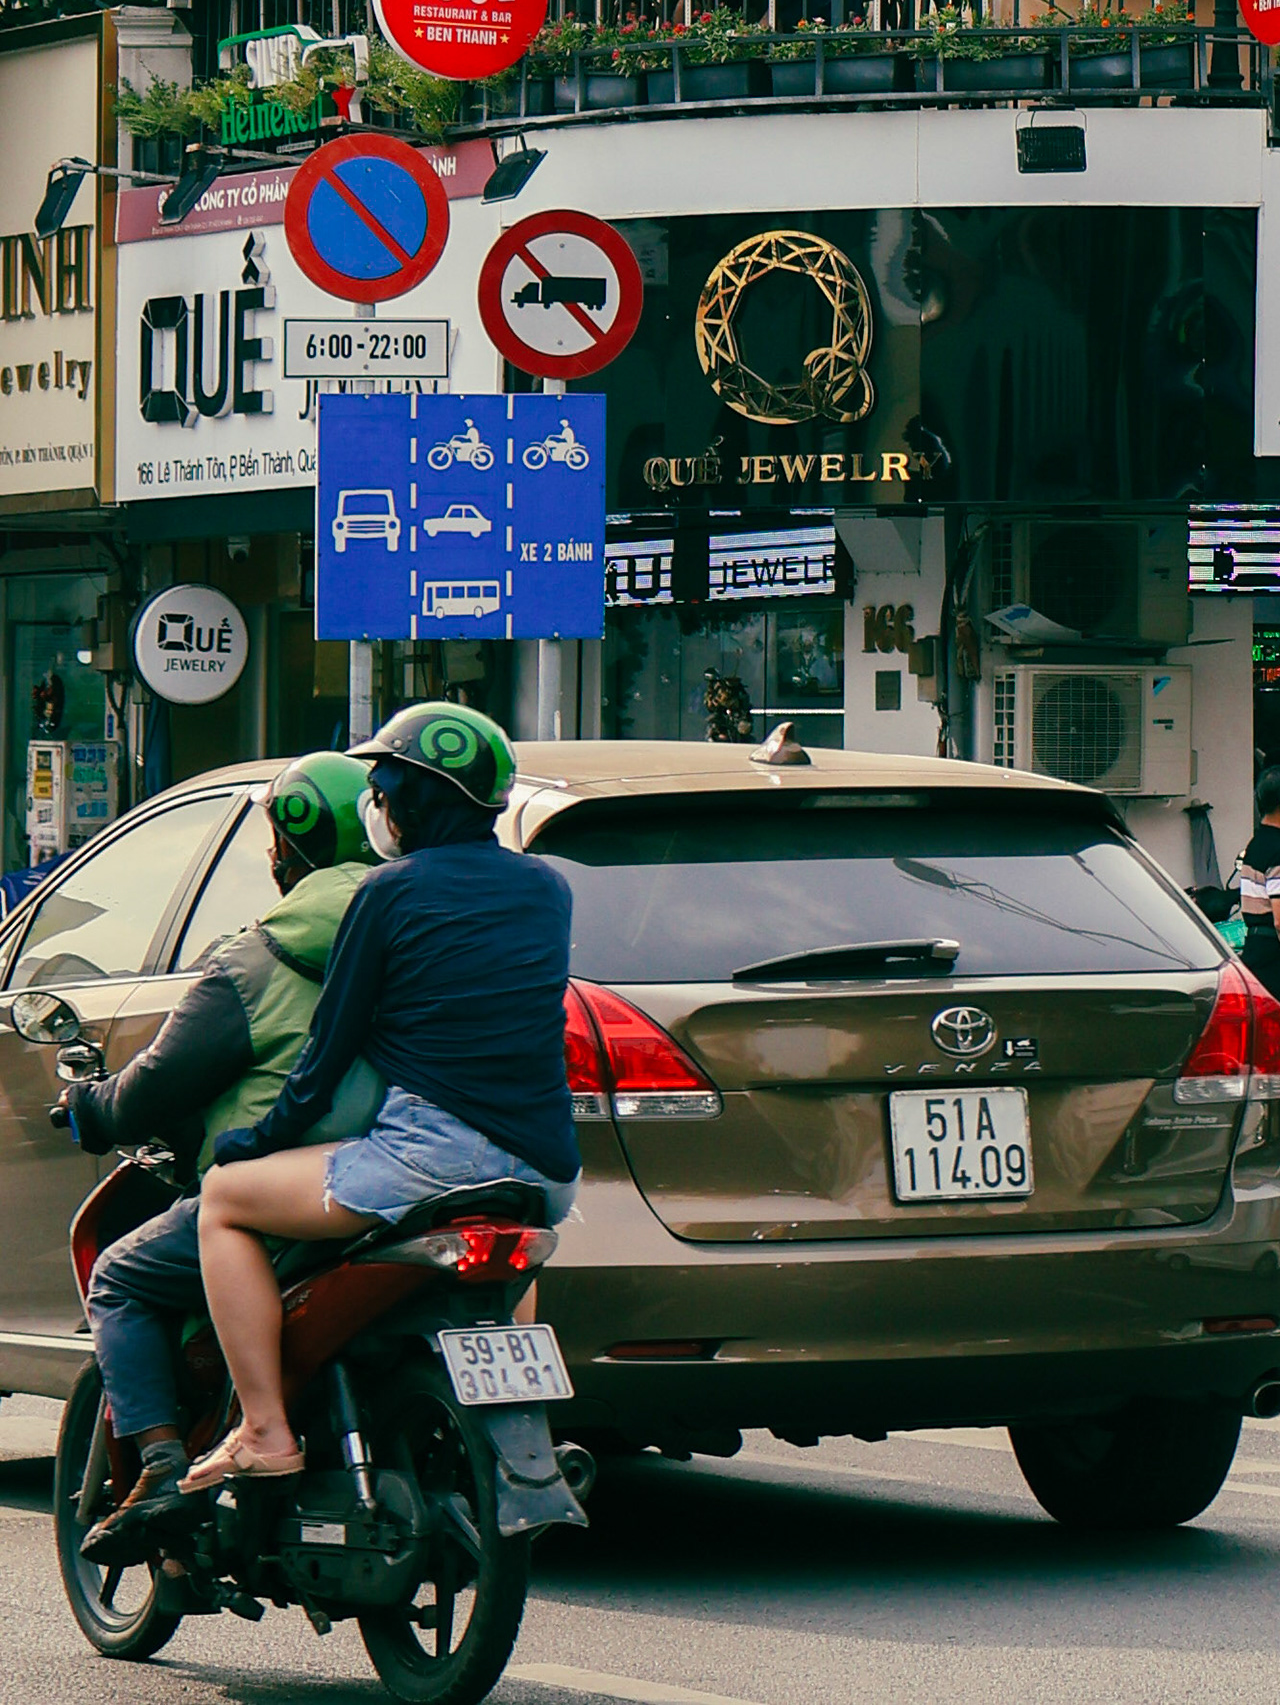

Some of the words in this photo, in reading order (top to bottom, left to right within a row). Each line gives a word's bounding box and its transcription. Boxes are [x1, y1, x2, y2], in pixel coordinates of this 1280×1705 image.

[414, 5, 478, 20] RESTAURANT
[481, 10, 489, 21] &
[491, 10, 512, 23] BAR
[427, 27, 452, 42] BEN
[456, 29, 497, 45] THANH
[227, 188, 241, 206] TY
[242, 179, 257, 205] CỔ
[140, 231, 276, 428] QUẾ
[138, 464, 153, 485] 166
[158, 461, 171, 483] Lê
[173, 458, 203, 481] Thánh
[206, 457, 228, 481] Tôn,
[262, 452, 295, 478] Thành,
[737, 452, 942, 484] JEWELRY
[520, 542, 537, 562] XE
[544, 542, 552, 561] 2
[557, 537, 593, 561] BÁNH
[157, 613, 233, 653] QUẾ
[164, 658, 226, 672] JEWELRY
[884, 1060, 1043, 1075] VENZA
[925, 1097, 997, 1142] 51A
[904, 1143, 1027, 1191] 114.09
[459, 1333, 539, 1365] 59-B1
